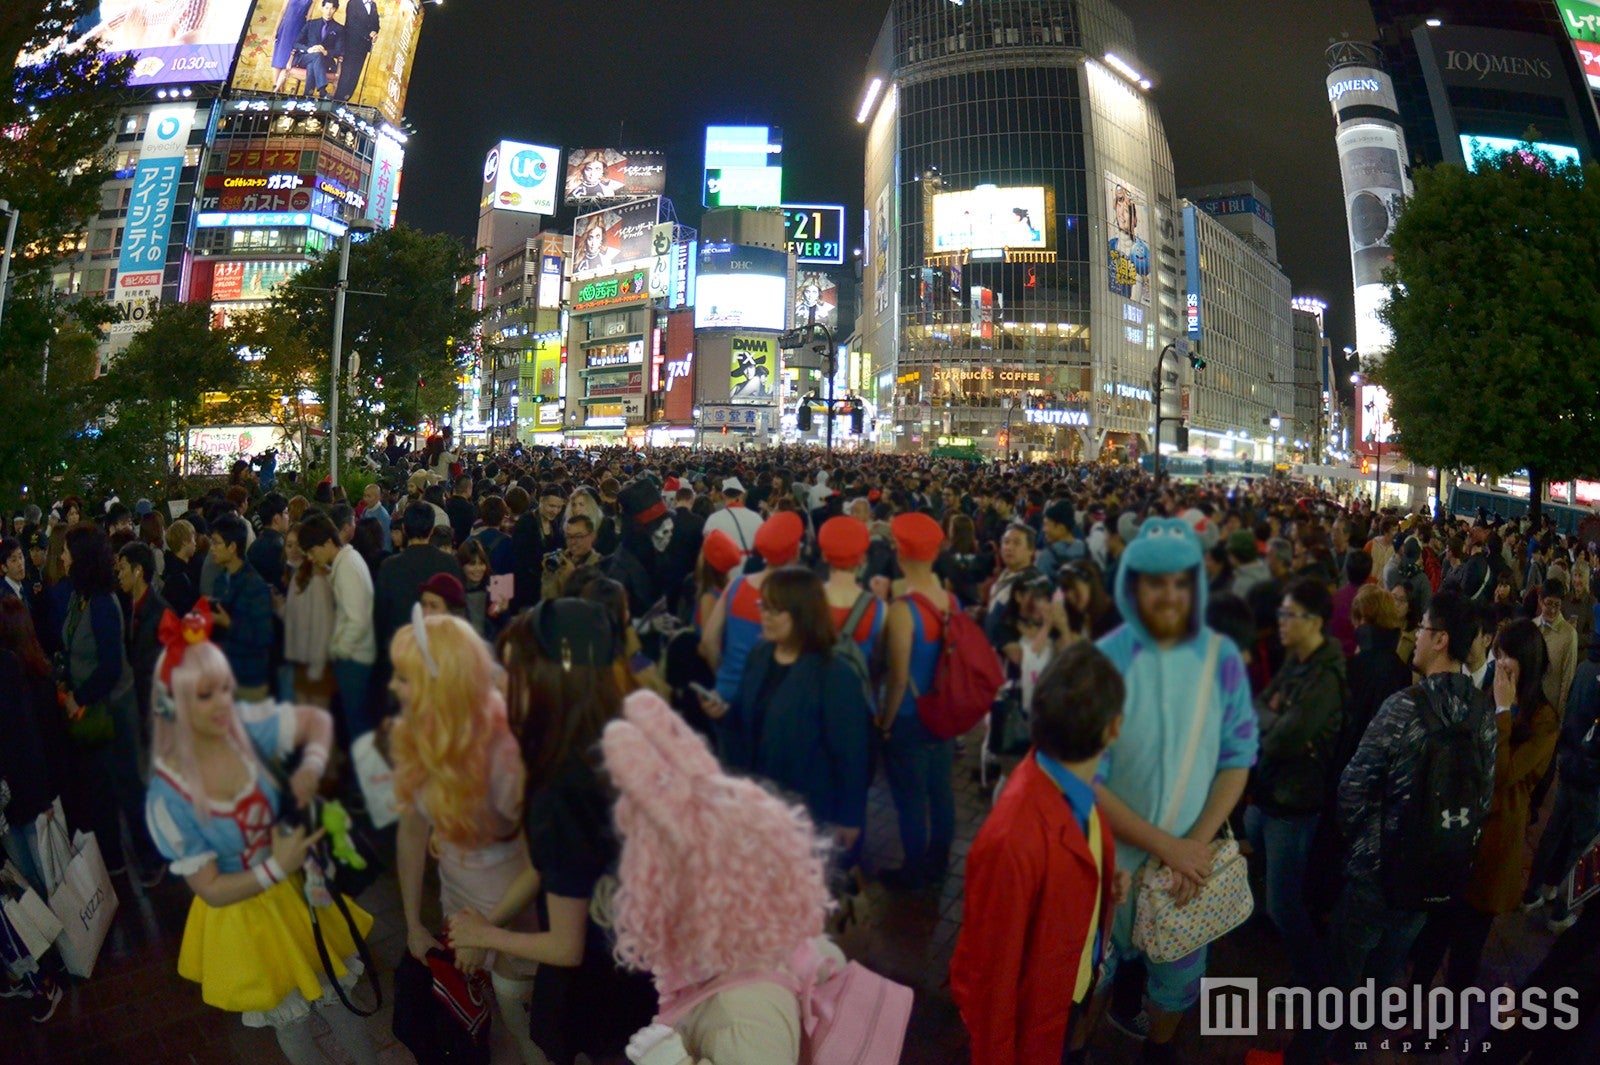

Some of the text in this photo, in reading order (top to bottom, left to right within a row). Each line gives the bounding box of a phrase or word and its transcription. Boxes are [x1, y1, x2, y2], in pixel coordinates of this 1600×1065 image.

[171, 56, 205, 71] 10.30
[229, 152, 298, 166] プライス
[318, 154, 359, 183] コンタクト
[512, 156, 547, 180] UC
[267, 174, 303, 190] ガスト
[203, 197, 219, 209] 7F
[242, 195, 286, 212] ガスト
[534, 199, 551, 208] VISA
[1205, 200, 1246, 213] SEIBU
[783, 242, 838, 257] EVER 21
[730, 261, 753, 269] DHC
[1187, 293, 1199, 332] SEIBU
[733, 338, 768, 352] DMM
[734, 353, 756, 364] FX
[933, 371, 1040, 381] STARBUCKS COFFEE
[1025, 409, 1089, 425] TSUTAYA
